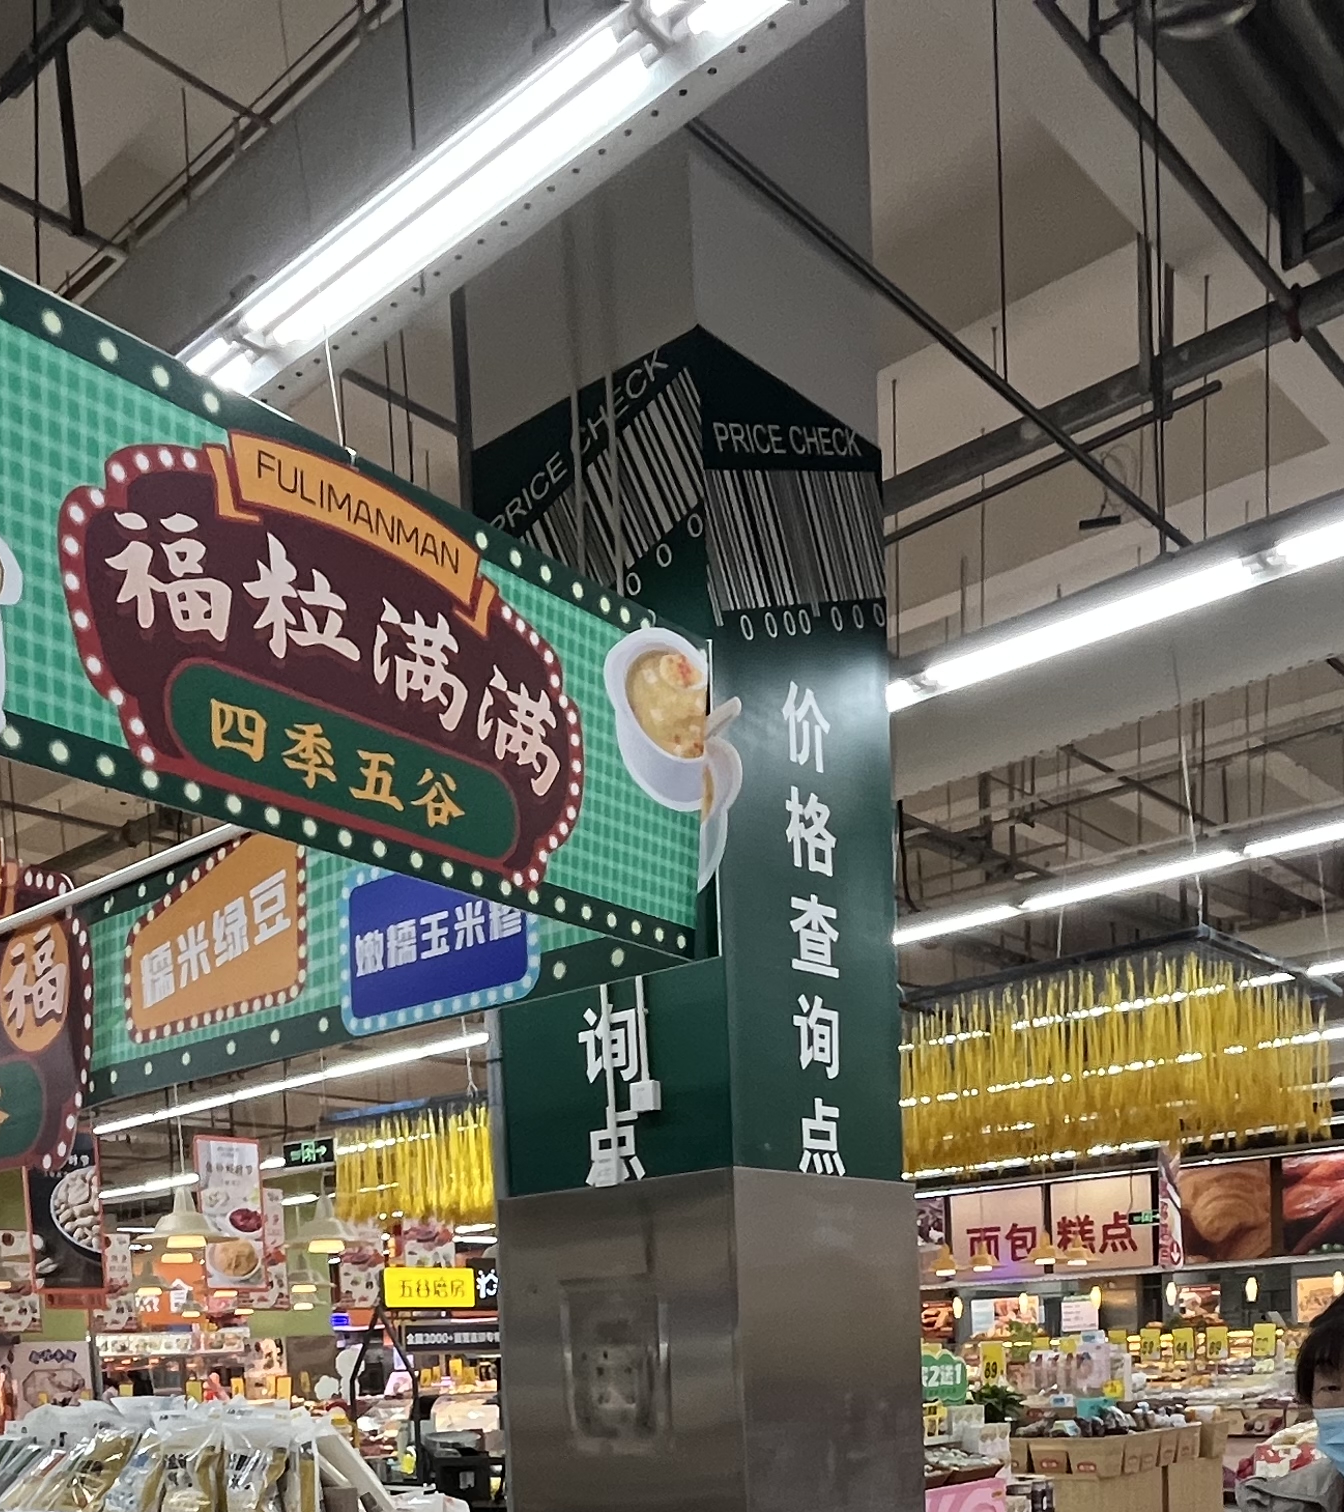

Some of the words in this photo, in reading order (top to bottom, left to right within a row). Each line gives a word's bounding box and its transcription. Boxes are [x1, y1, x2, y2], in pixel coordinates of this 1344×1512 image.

[713, 422, 786, 456] PRICE
[788, 424, 863, 458] CHECK
[255, 447, 463, 578] FULIMANMAN
[105, 508, 561, 798] 福粒满满
[208, 697, 466, 830] 四季五谷
[139, 869, 294, 1011] 糯米绿豆
[781, 681, 847, 1177] 价格查询点
[399, 1276, 466, 1299] 五谷磨房
